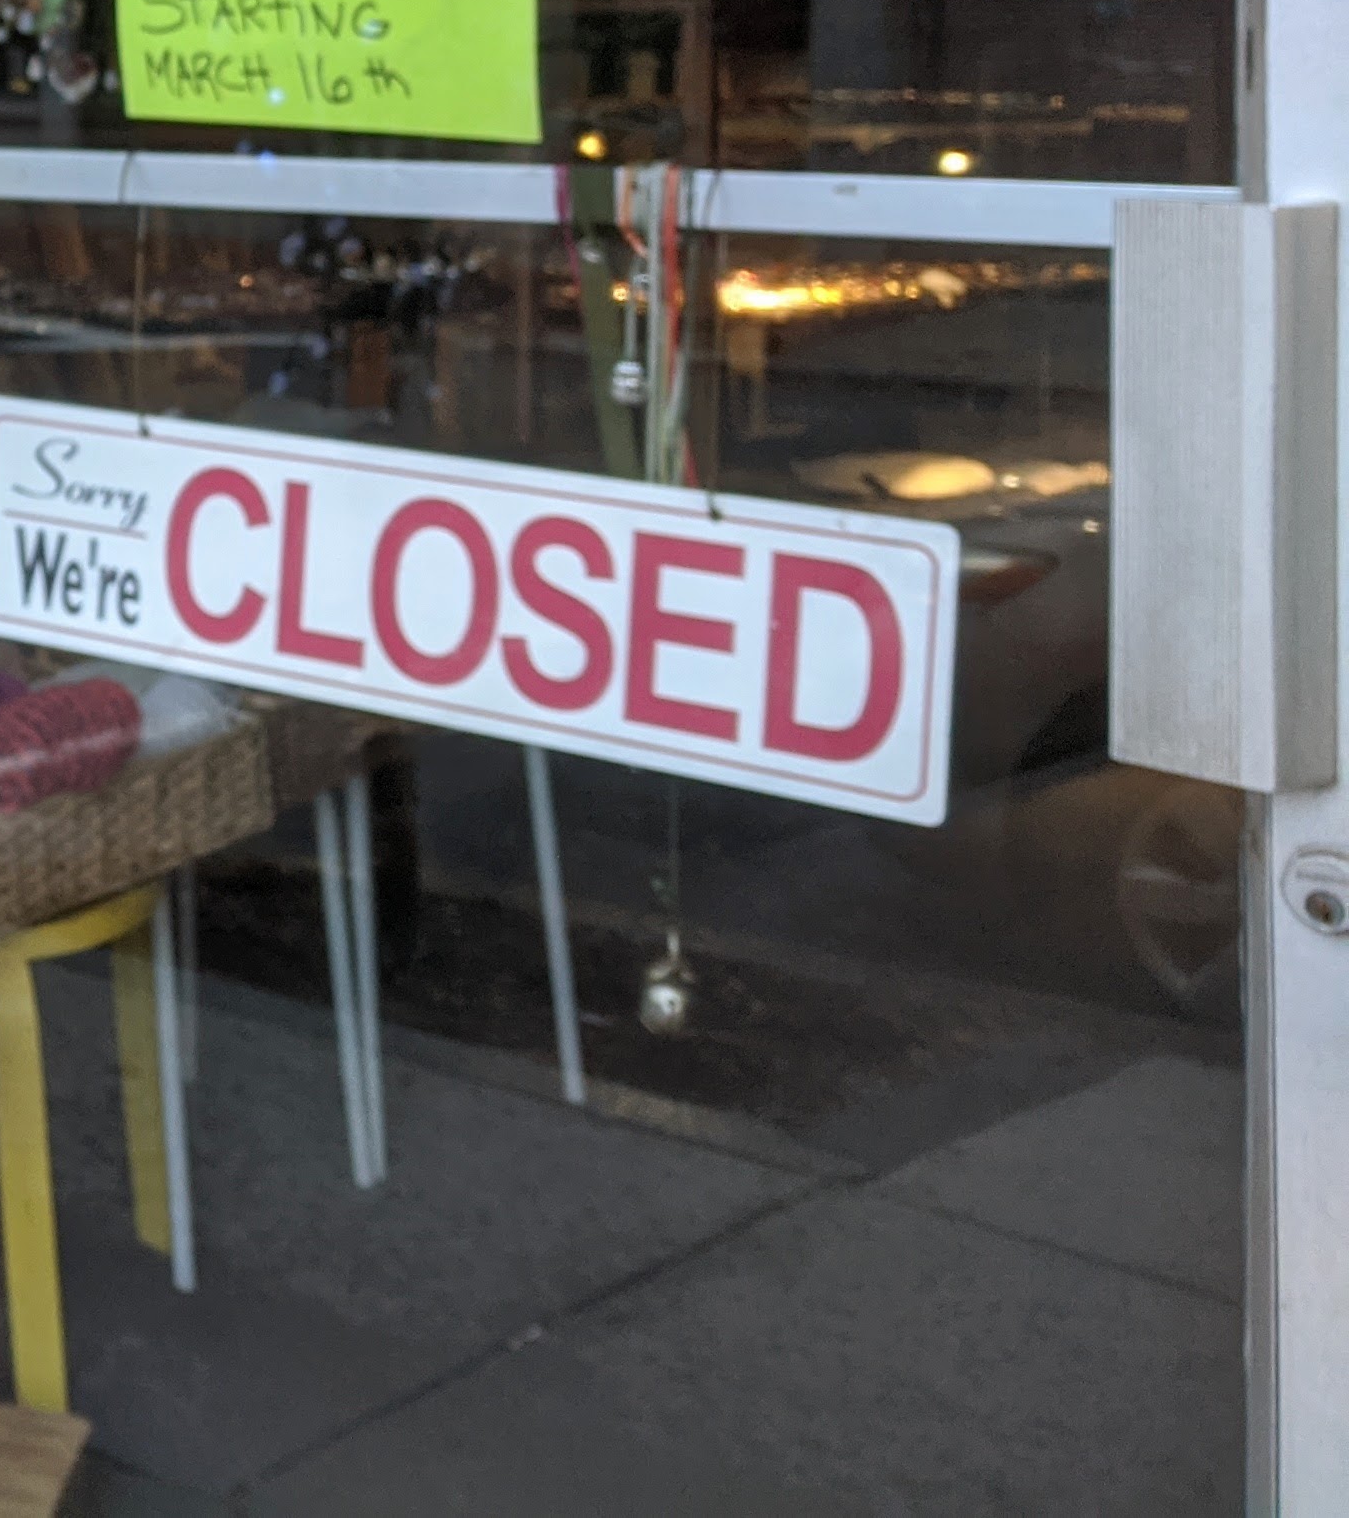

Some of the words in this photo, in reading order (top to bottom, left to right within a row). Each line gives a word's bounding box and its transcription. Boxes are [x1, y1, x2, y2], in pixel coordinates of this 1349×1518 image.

[145, 47, 270, 102] MARCH
[11, 436, 149, 530] Sorry
[14, 525, 141, 626] We're
[166, 467, 905, 763] CLOSED
